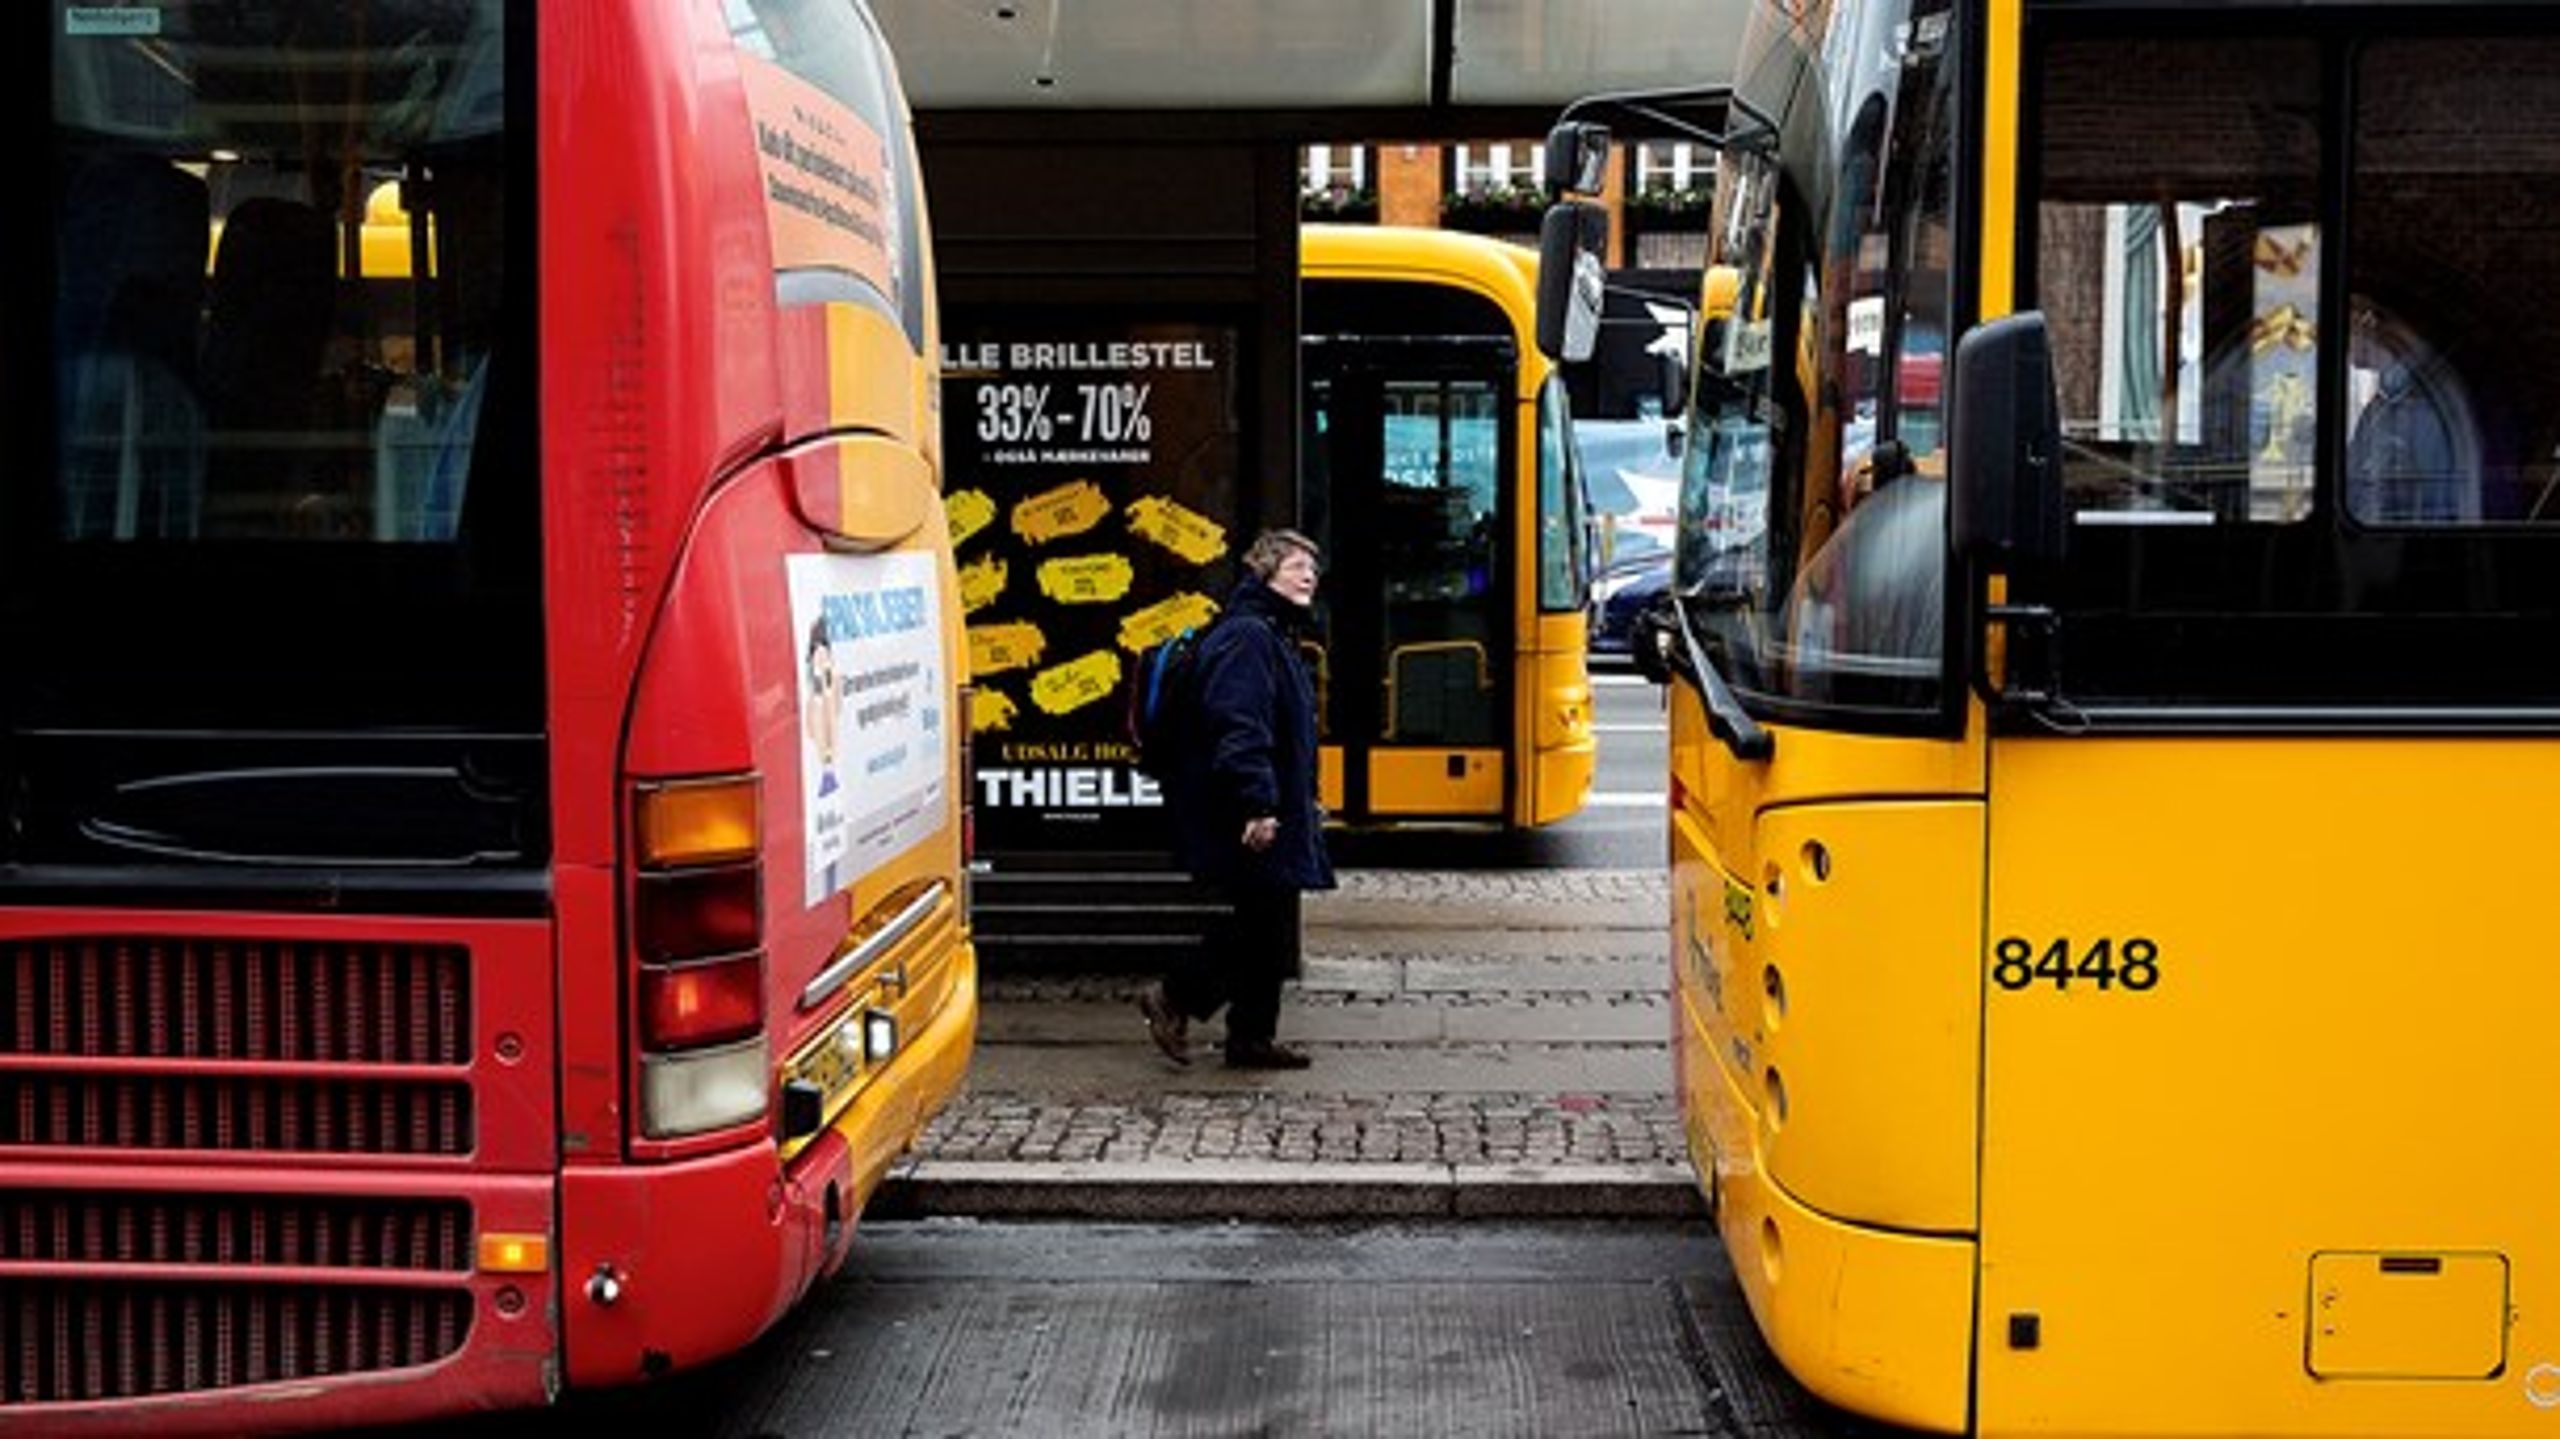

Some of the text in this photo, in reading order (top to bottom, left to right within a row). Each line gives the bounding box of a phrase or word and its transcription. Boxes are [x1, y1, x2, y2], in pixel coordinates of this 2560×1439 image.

[940, 343, 1214, 369] LLE BRILLESTEL
[1002, 743, 1088, 762] UDSALG
[976, 768, 1164, 806] THIELE
[1992, 937, 2159, 991] 8448
